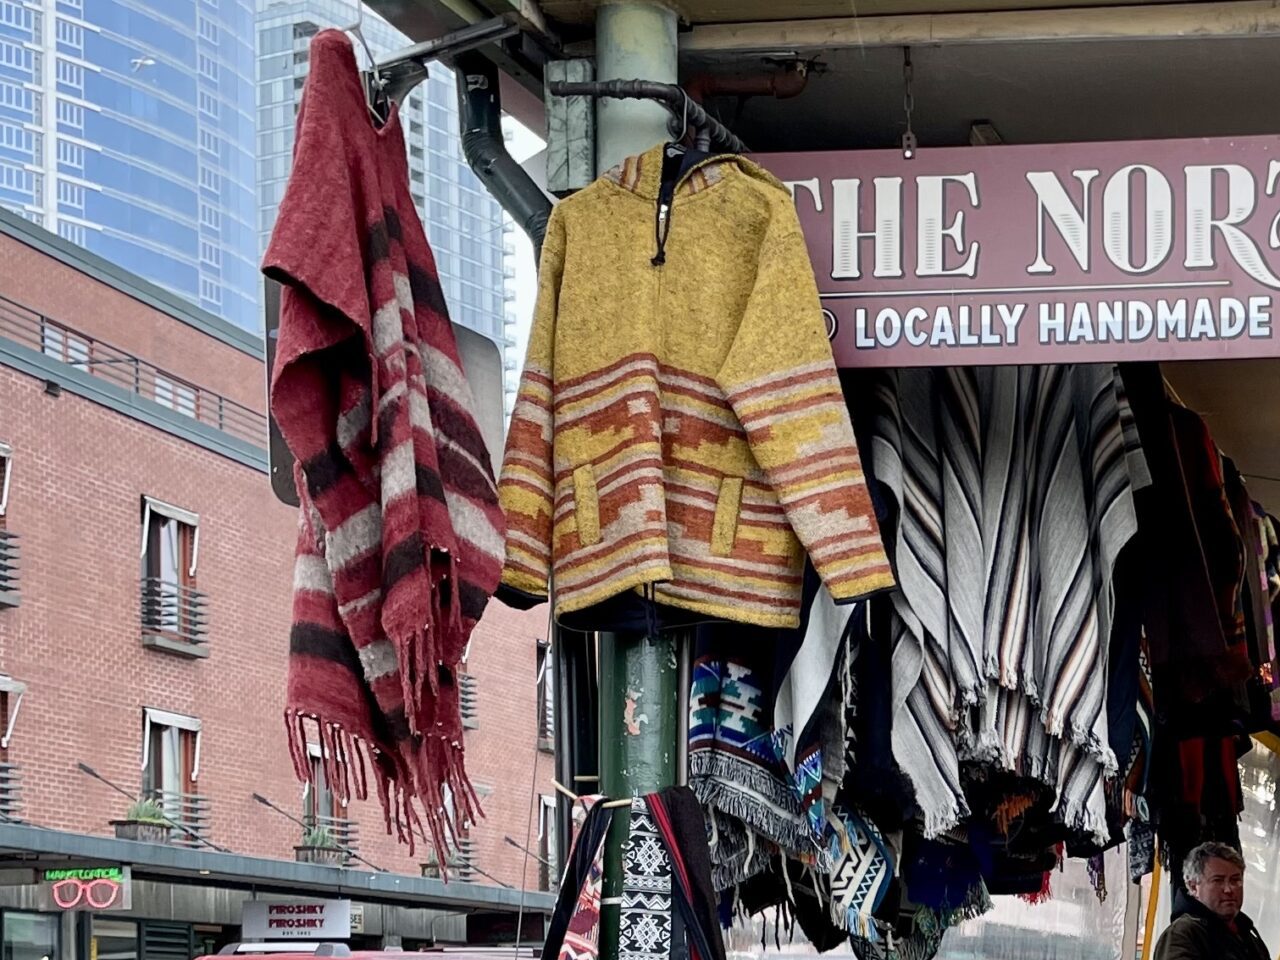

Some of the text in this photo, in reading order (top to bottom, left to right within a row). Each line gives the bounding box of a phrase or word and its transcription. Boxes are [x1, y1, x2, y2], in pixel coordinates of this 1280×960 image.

[854, 303, 1028, 348] LOCALLY
[1038, 293, 1273, 342] HANDMADE
[268, 904, 325, 914] PIROSHKY
[268, 918, 325, 928] PIROSHKY
